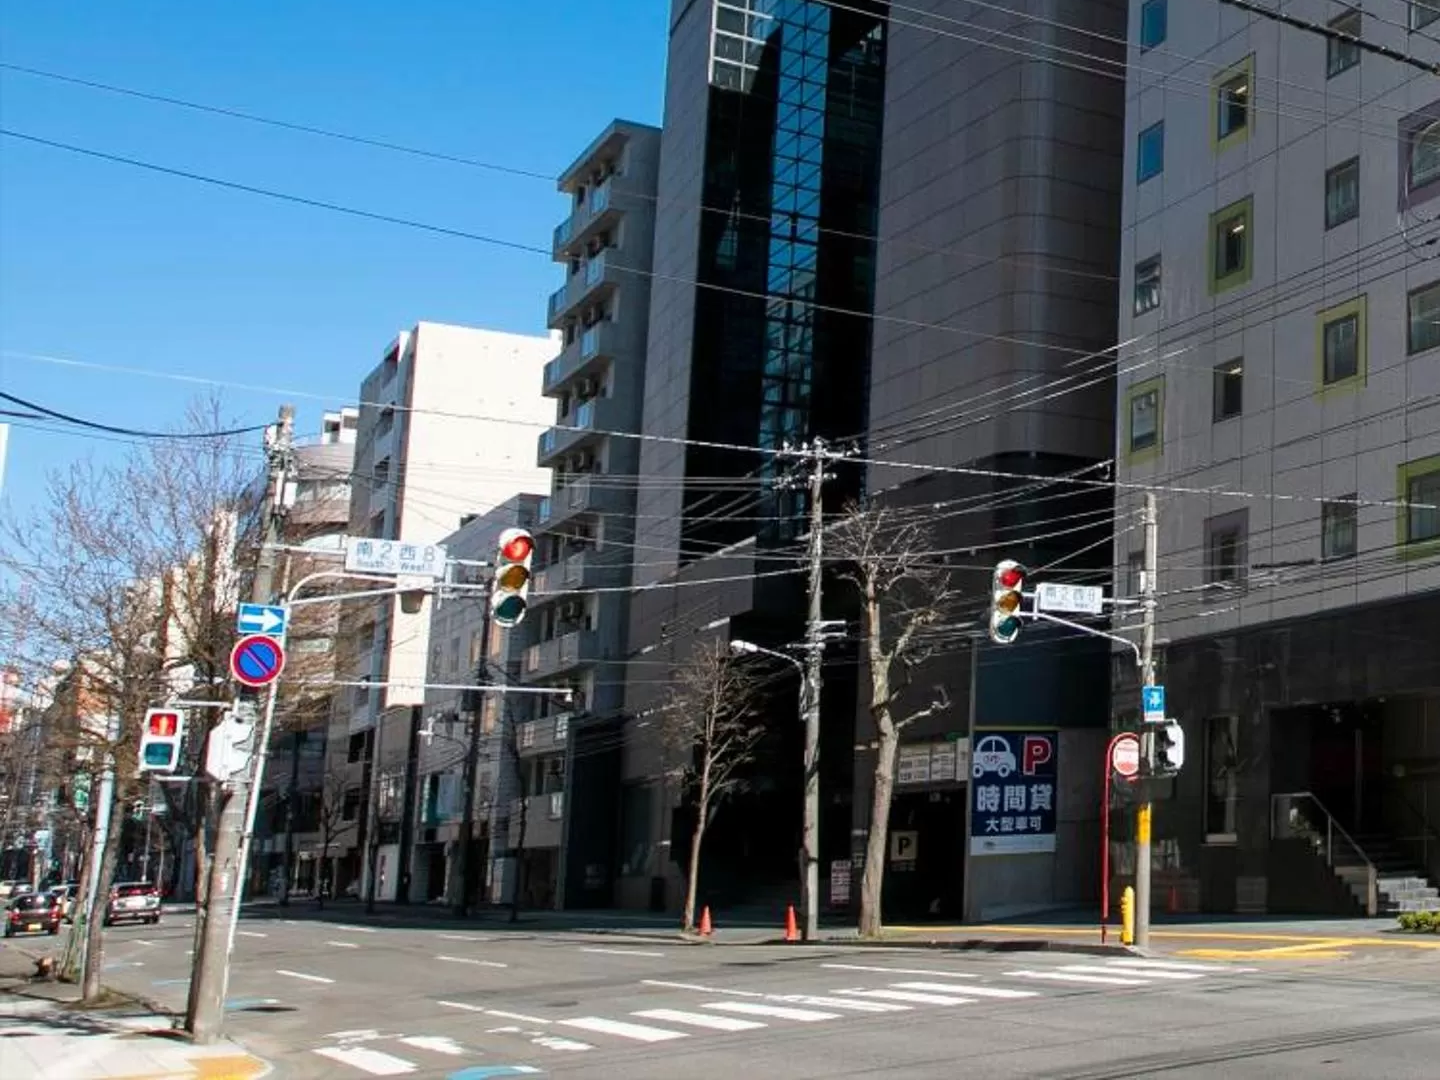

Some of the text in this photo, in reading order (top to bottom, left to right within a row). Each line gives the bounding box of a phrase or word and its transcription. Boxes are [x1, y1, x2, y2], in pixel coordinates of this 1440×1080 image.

[1023, 736, 1052, 775] P
[977, 784, 1053, 812] 時間貸
[985, 816, 1042, 832] 大型車可
[898, 837, 912, 856] P
